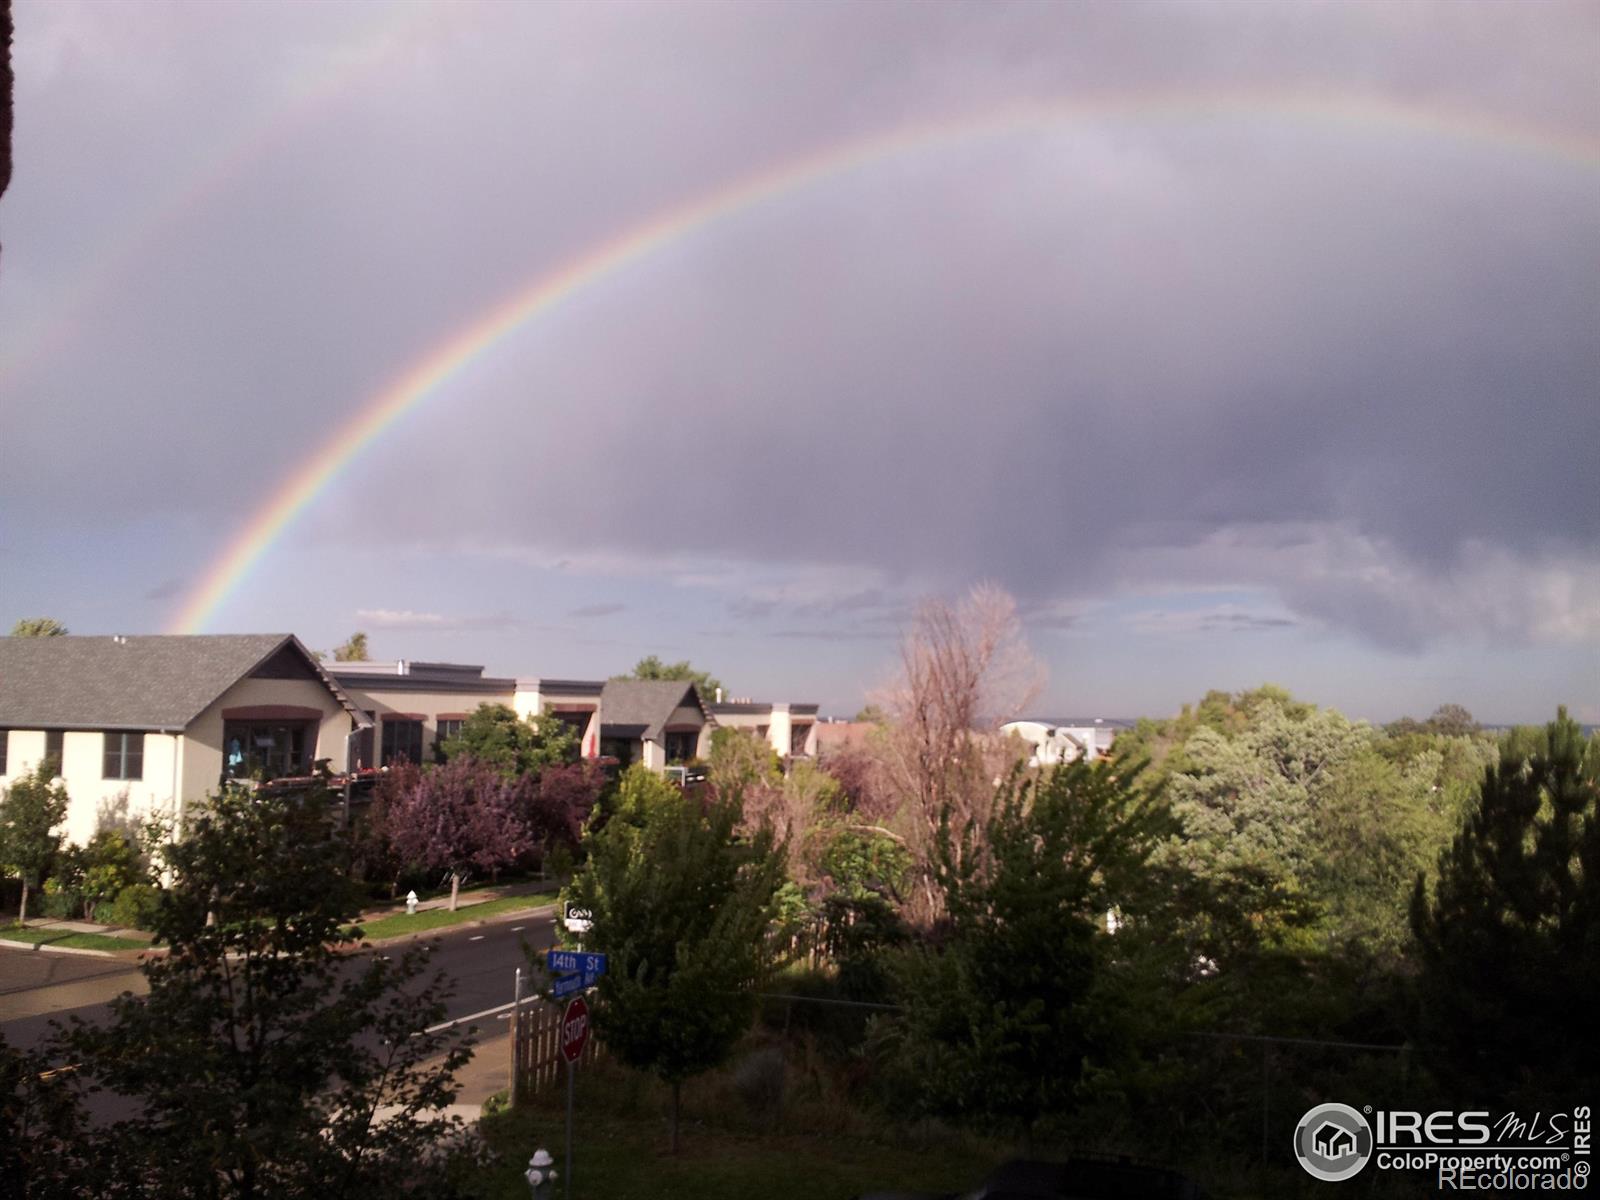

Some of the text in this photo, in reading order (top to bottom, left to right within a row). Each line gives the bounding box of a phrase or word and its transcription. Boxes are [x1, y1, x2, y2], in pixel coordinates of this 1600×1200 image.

[552, 953, 599, 970] 14th St
[564, 1014, 586, 1045] STOP
